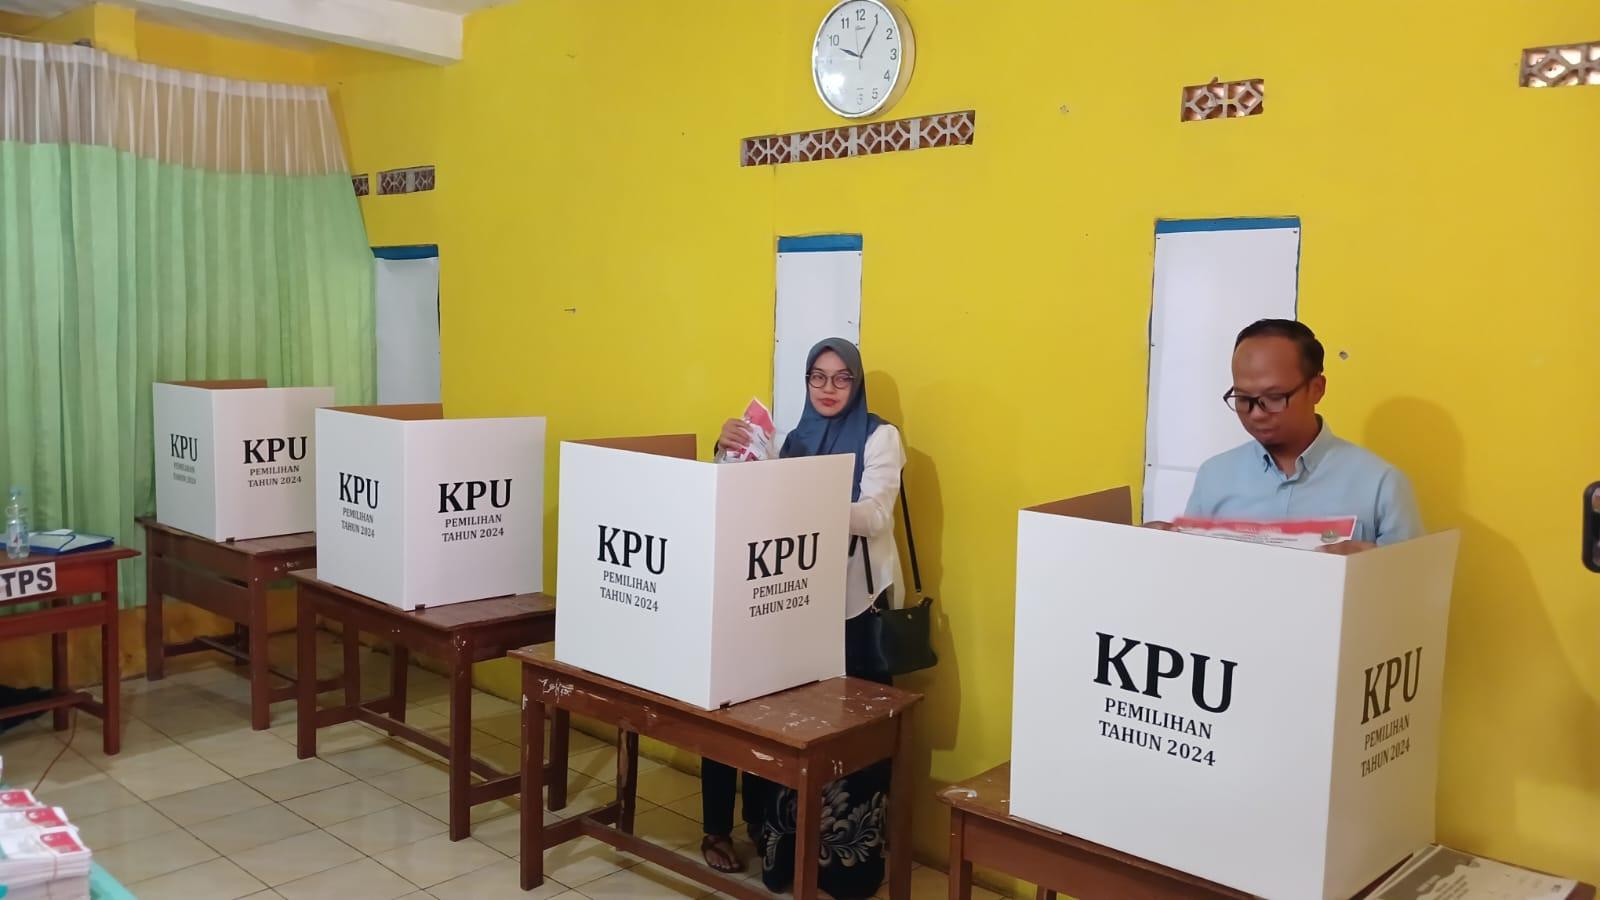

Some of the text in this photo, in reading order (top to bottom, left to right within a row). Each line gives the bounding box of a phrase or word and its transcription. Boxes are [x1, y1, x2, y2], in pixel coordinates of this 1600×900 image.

[841, 17, 850, 29] 11
[856, 9, 866, 21] 12
[829, 34, 840, 47] 10
[886, 28, 893, 40] 2
[890, 48, 897, 60] 3
[884, 70, 891, 81] 4
[170, 433, 198, 461] KPU
[242, 436, 307, 464] KPU
[248, 476, 302, 487] TAHUN 2024
[250, 465, 300, 476] PEMILIHAN
[339, 472, 379, 509] KPU
[438, 478, 512, 513] KPU
[342, 507, 374, 523] PEMILIHAN
[445, 514, 502, 528] PEMILIHAN
[341, 520, 375, 538] TAHUN 2024
[442, 527, 504, 542] TAHUN 2024
[597, 524, 667, 575] KPU
[746, 532, 820, 581] KPU
[0, 567, 53, 597] TPS
[603, 570, 657, 594] PEMILIHAN
[753, 578, 808, 600] PEMILIHAN
[600, 587, 658, 612] TAHUN 2024
[749, 594, 810, 618] TAHUN 2024
[1093, 632, 1238, 714] KPU
[1360, 646, 1423, 725] KPU
[1104, 697, 1213, 740] PEMILIHAN
[1098, 720, 1216, 766] TAHUN 2024
[1364, 713, 1410, 751] PEMILIHAN
[1360, 737, 1410, 778] TAHUN 2024
